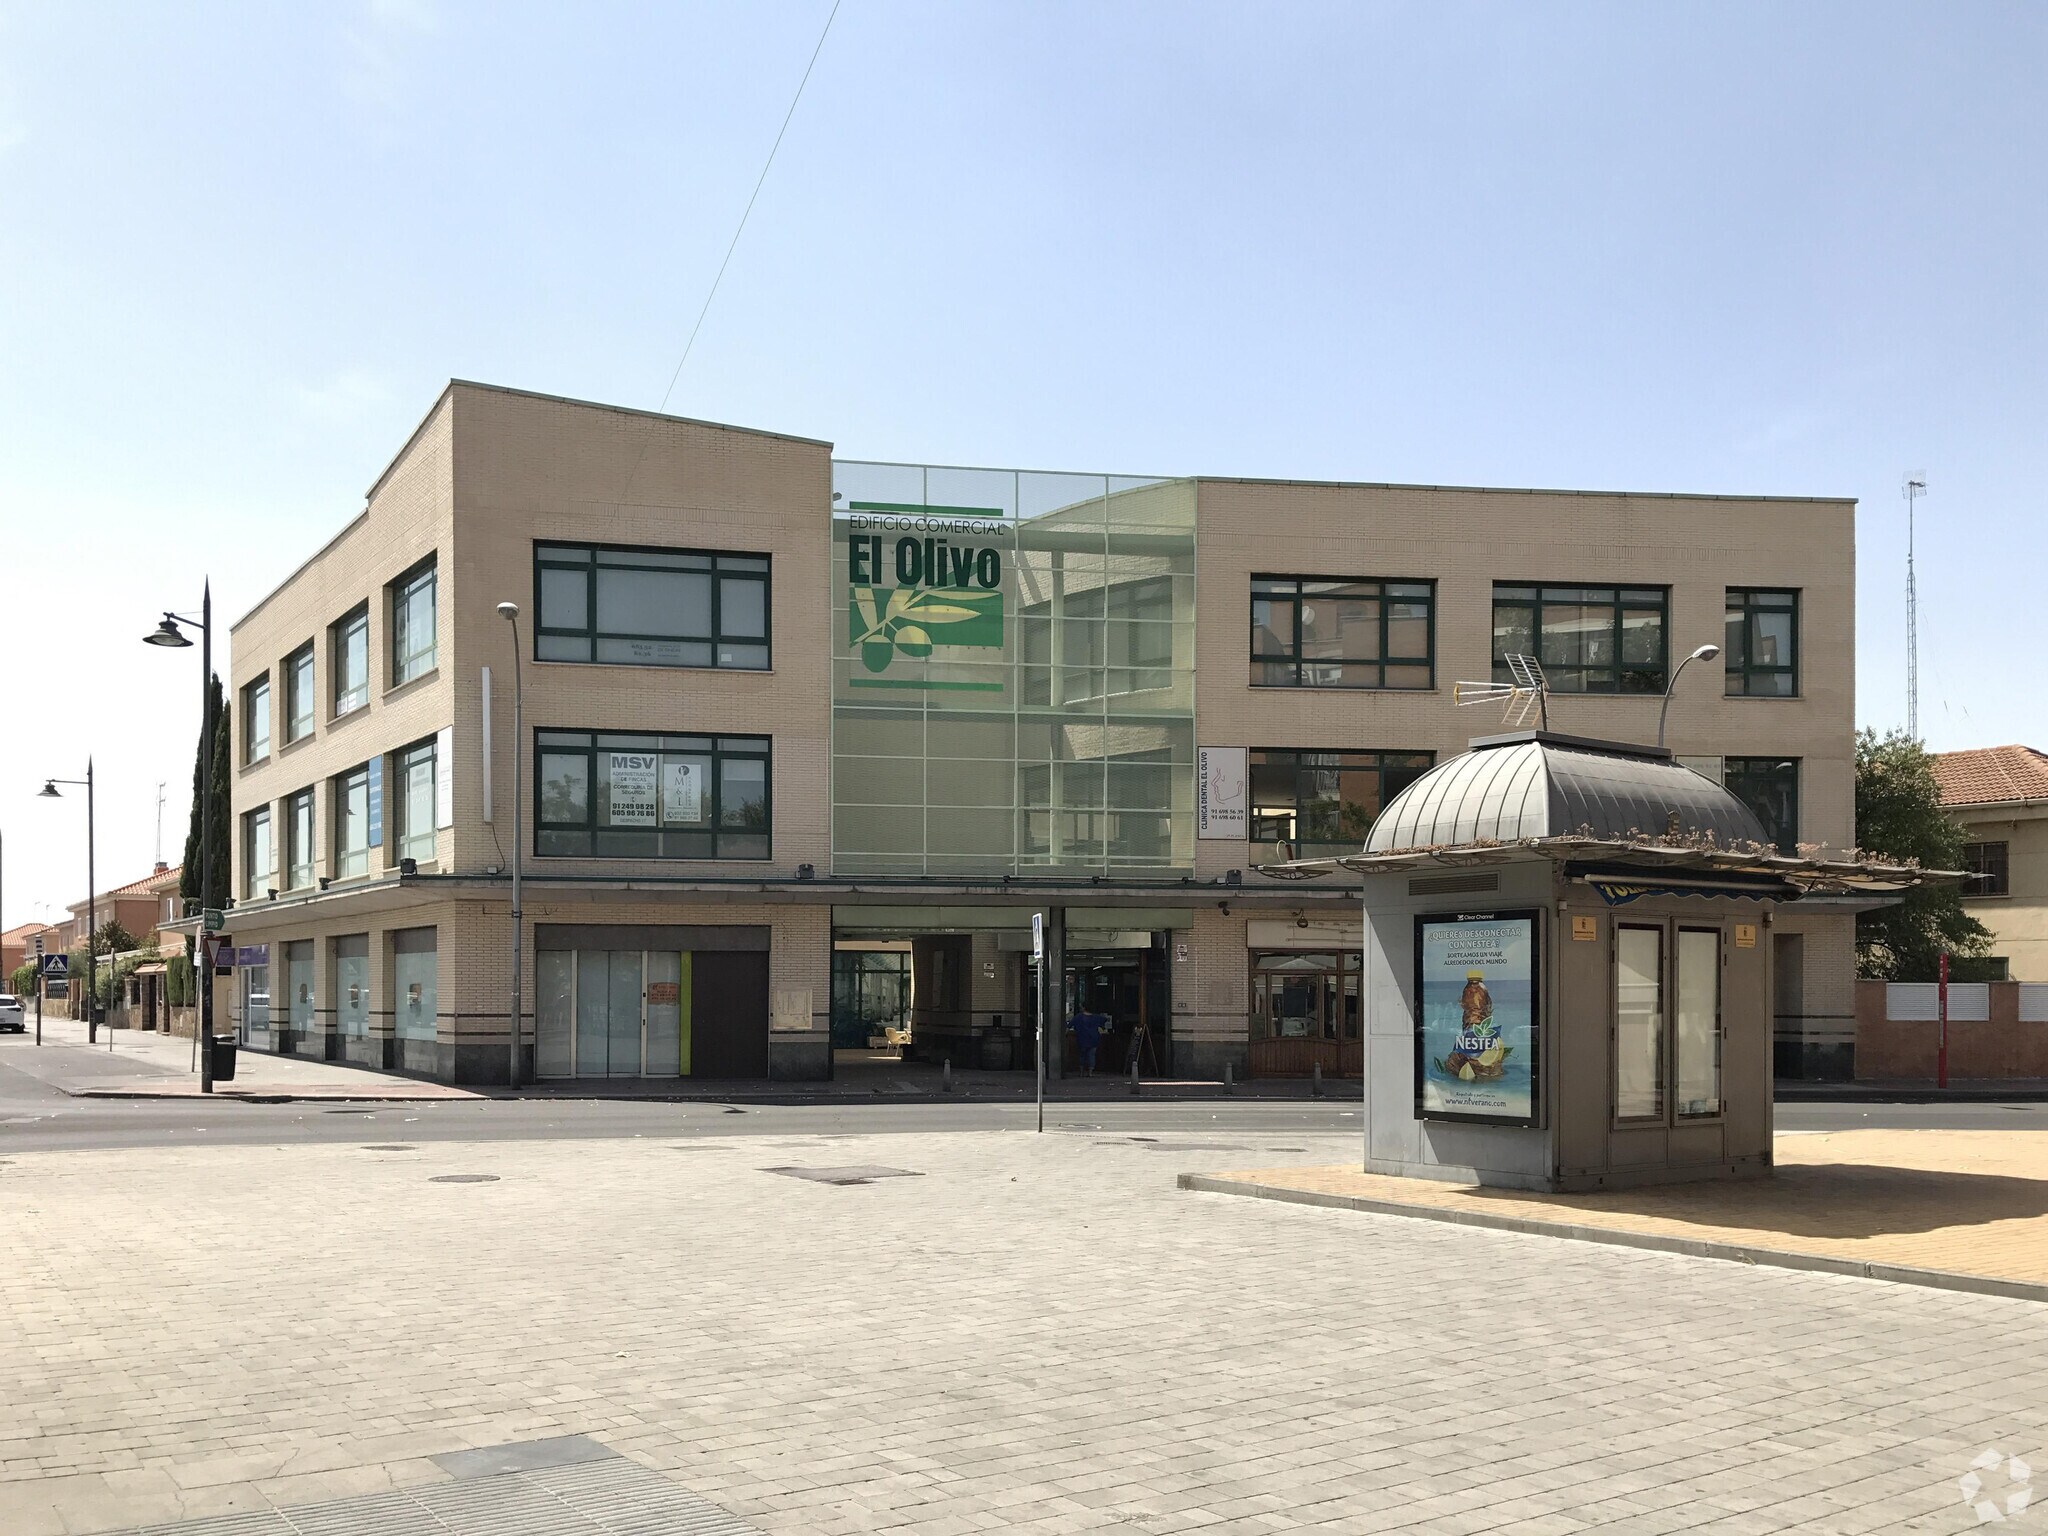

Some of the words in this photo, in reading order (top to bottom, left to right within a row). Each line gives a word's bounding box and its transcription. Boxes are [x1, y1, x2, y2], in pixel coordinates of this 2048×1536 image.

[850, 515, 912, 531] EDIFICIO
[915, 518, 1004, 536] COMERCIAL
[849, 534, 882, 585] El
[895, 536, 1001, 589] Olivo
[612, 756, 655, 769] MSV
[674, 776, 685, 786] M
[1201, 771, 1207, 780] EL
[1428, 930, 1463, 942] ¿QUIERES
[1464, 927, 1522, 938] DESCONECTAR
[1448, 940, 1465, 949] CON
[1466, 939, 1500, 949] NESTEA?
[1447, 951, 1479, 959] SORTEAMOS
[1455, 1035, 1500, 1051] NESTEA
